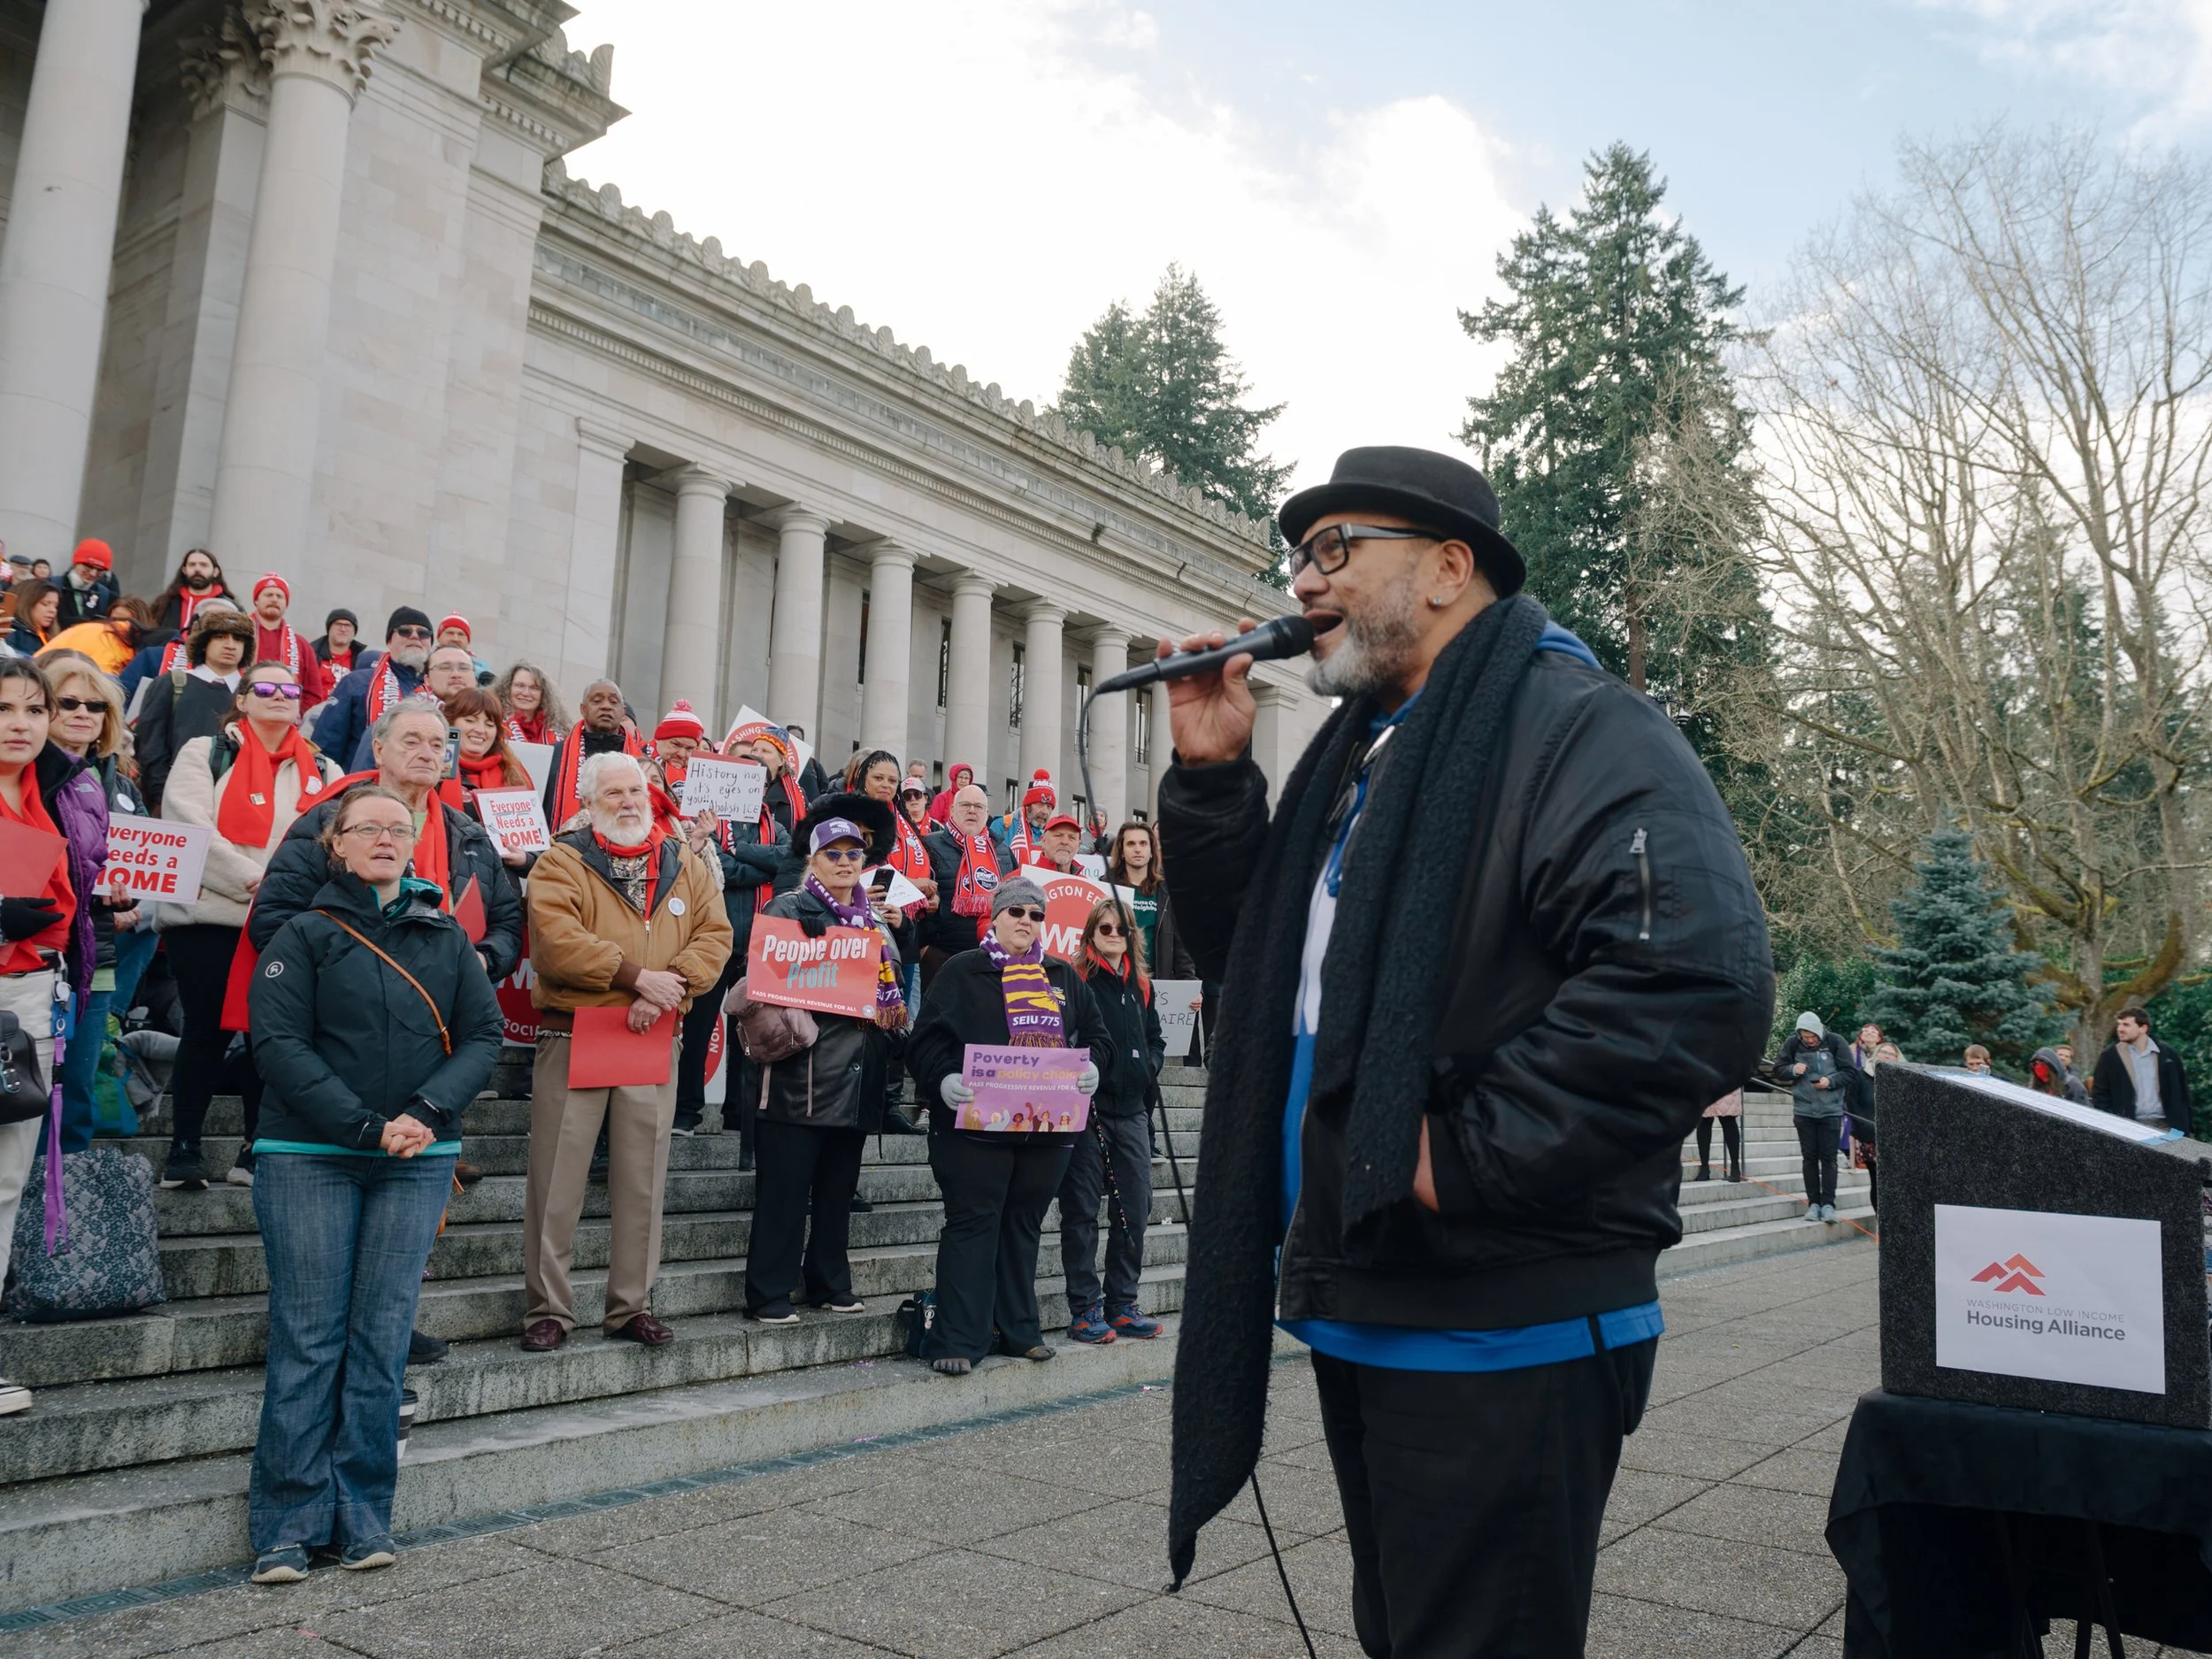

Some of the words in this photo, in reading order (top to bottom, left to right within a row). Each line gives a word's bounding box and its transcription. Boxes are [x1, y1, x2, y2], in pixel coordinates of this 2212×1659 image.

[691, 762, 737, 787] History
[719, 786, 741, 798] eyes
[489, 800, 531, 815] Everyone
[709, 800, 739, 813] Abolish
[743, 803, 758, 814] ICE
[495, 815, 526, 829] Needs
[529, 817, 534, 826] a
[108, 826, 187, 848] veryone
[106, 843, 158, 866] eeds
[166, 856, 178, 869] a
[762, 934, 826, 966] People
[830, 937, 870, 960] over
[787, 961, 839, 990] Profit
[767, 994, 806, 1005] PROGRESSIVE
[806, 999, 833, 1009] REVENUE
[1012, 1016, 1038, 1026] SEIU
[1041, 1016, 1060, 1026] 775
[973, 1052, 1040, 1067] Poverty
[972, 1066, 984, 1077] is
[986, 1069, 995, 1078] a
[996, 1068, 1040, 1081] policy
[986, 1082, 1027, 1091] PROGRESSIVE
[1966, 1299, 2043, 1314] WASHINGTON
[2047, 1308, 2074, 1317] LOW
[2078, 1310, 2124, 1323] INCOME
[1967, 1310, 2044, 1334] Housing
[2047, 1319, 2126, 1340] Alliance
